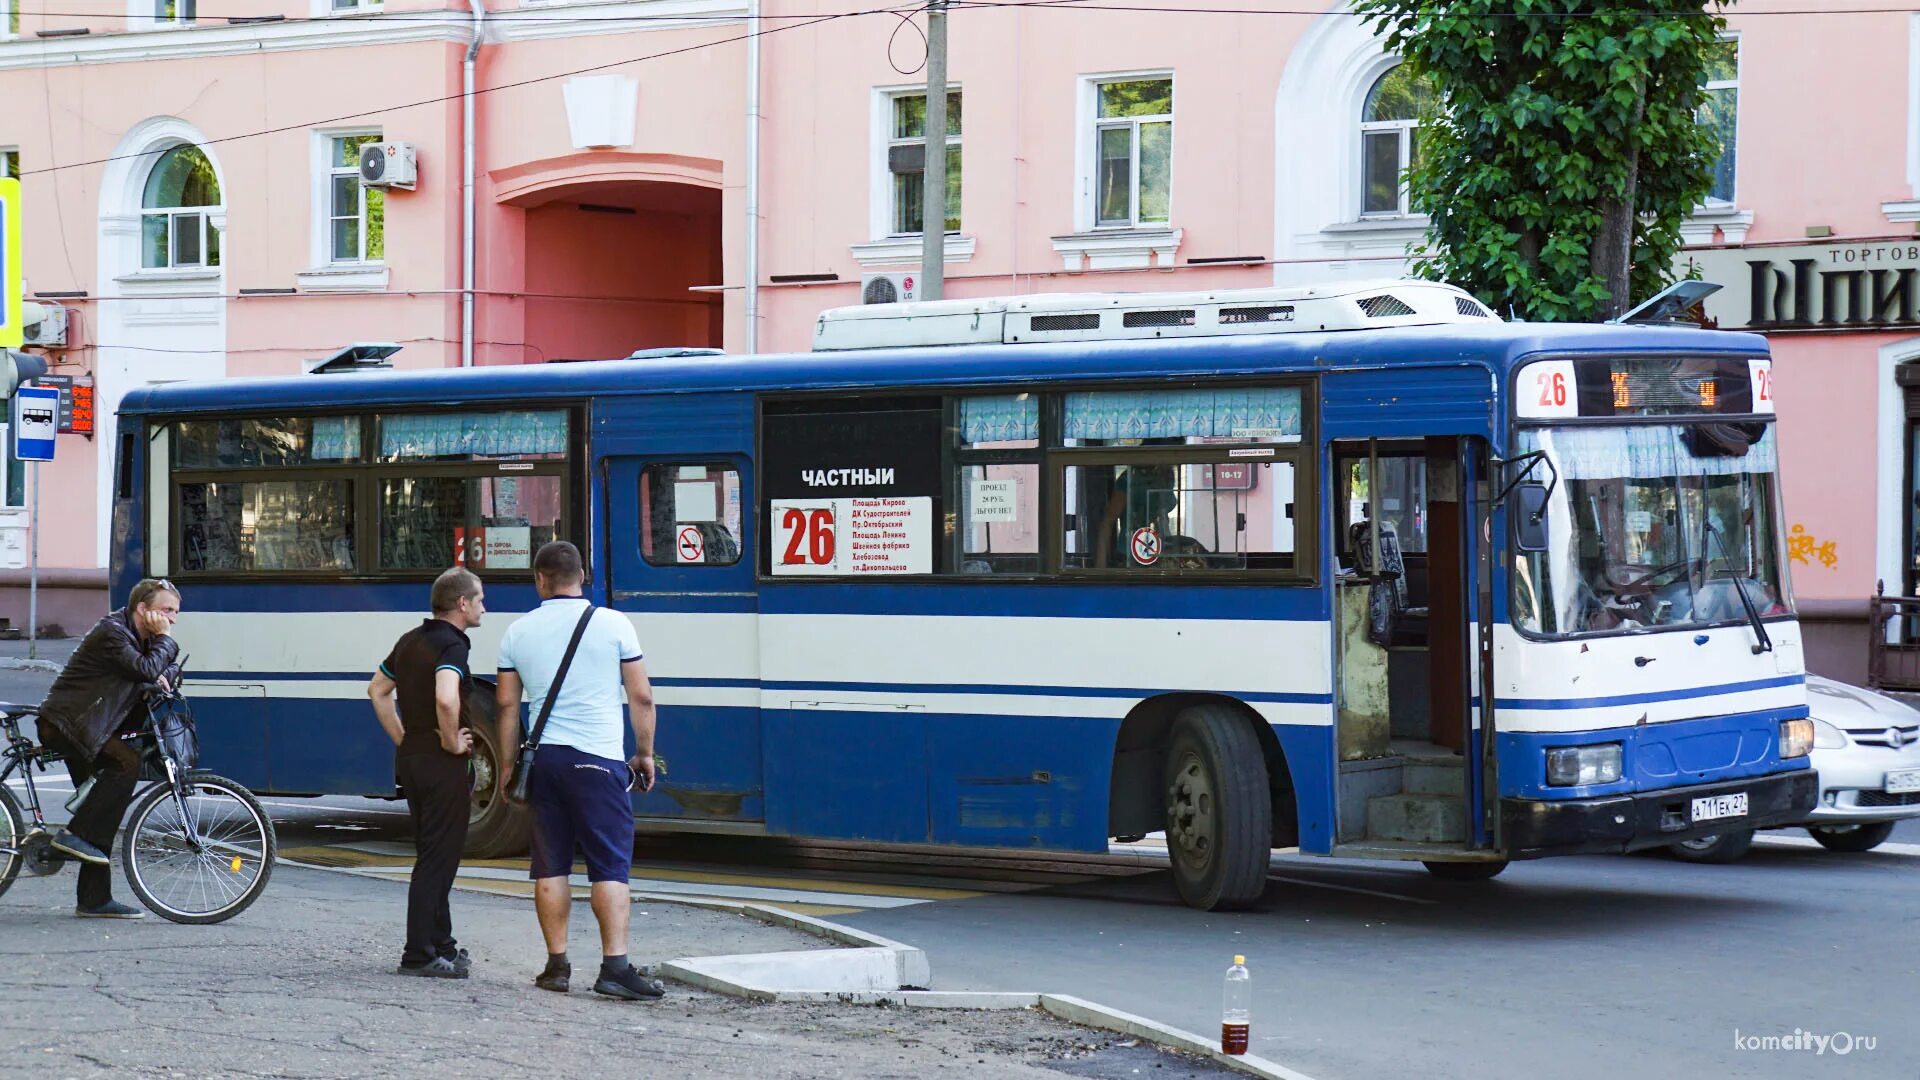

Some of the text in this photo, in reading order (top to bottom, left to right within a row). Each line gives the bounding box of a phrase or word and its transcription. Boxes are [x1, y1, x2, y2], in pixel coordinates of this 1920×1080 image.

[1537, 372, 1566, 406] 26
[1221, 471, 1242, 479] 10-17
[852, 499, 880, 508] Площадь
[852, 510, 861, 518] ДК
[783, 508, 835, 565] 26
[852, 531, 880, 540] Площадь
